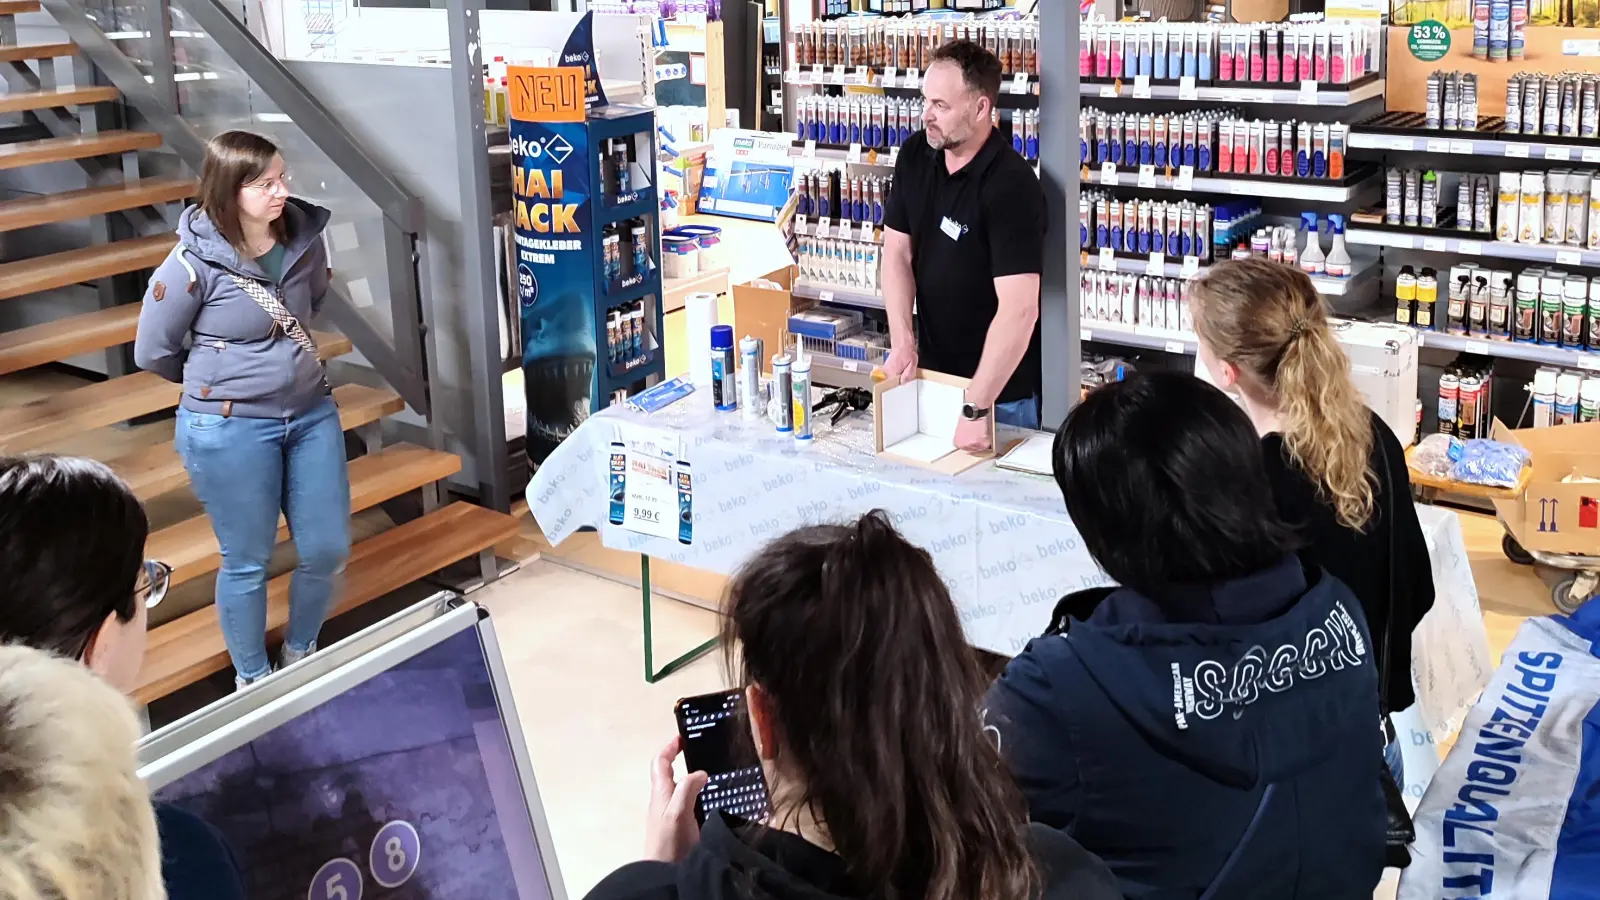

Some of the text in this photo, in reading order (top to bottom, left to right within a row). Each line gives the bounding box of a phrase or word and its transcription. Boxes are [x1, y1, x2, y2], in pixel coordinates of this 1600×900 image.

[1413, 25, 1446, 40] 53 %
[564, 53, 581, 63] beko
[514, 74, 577, 114] NEU
[512, 165, 564, 199] HAI
[520, 248, 556, 265] EXTREM
[724, 453, 755, 473] beko
[537, 474, 566, 505] beko
[762, 471, 794, 493] beko
[847, 480, 881, 500] beko
[633, 507, 652, 520] 9,99
[653, 511, 660, 521] €
[718, 494, 747, 513] beko
[796, 498, 828, 519] beko
[895, 503, 928, 525] beko
[547, 507, 572, 542] beko
[749, 517, 780, 537] beko
[988, 512, 1026, 535] beko
[703, 535, 732, 553] beko
[931, 532, 967, 554] beko
[1036, 536, 1077, 559] beko
[979, 557, 1018, 580] beko
[1020, 584, 1058, 606] beko
[961, 603, 998, 623] beko
[1442, 650, 1564, 900] SPITZENQUALIT
[384, 836, 406, 872] 8
[325, 873, 347, 900] 5
